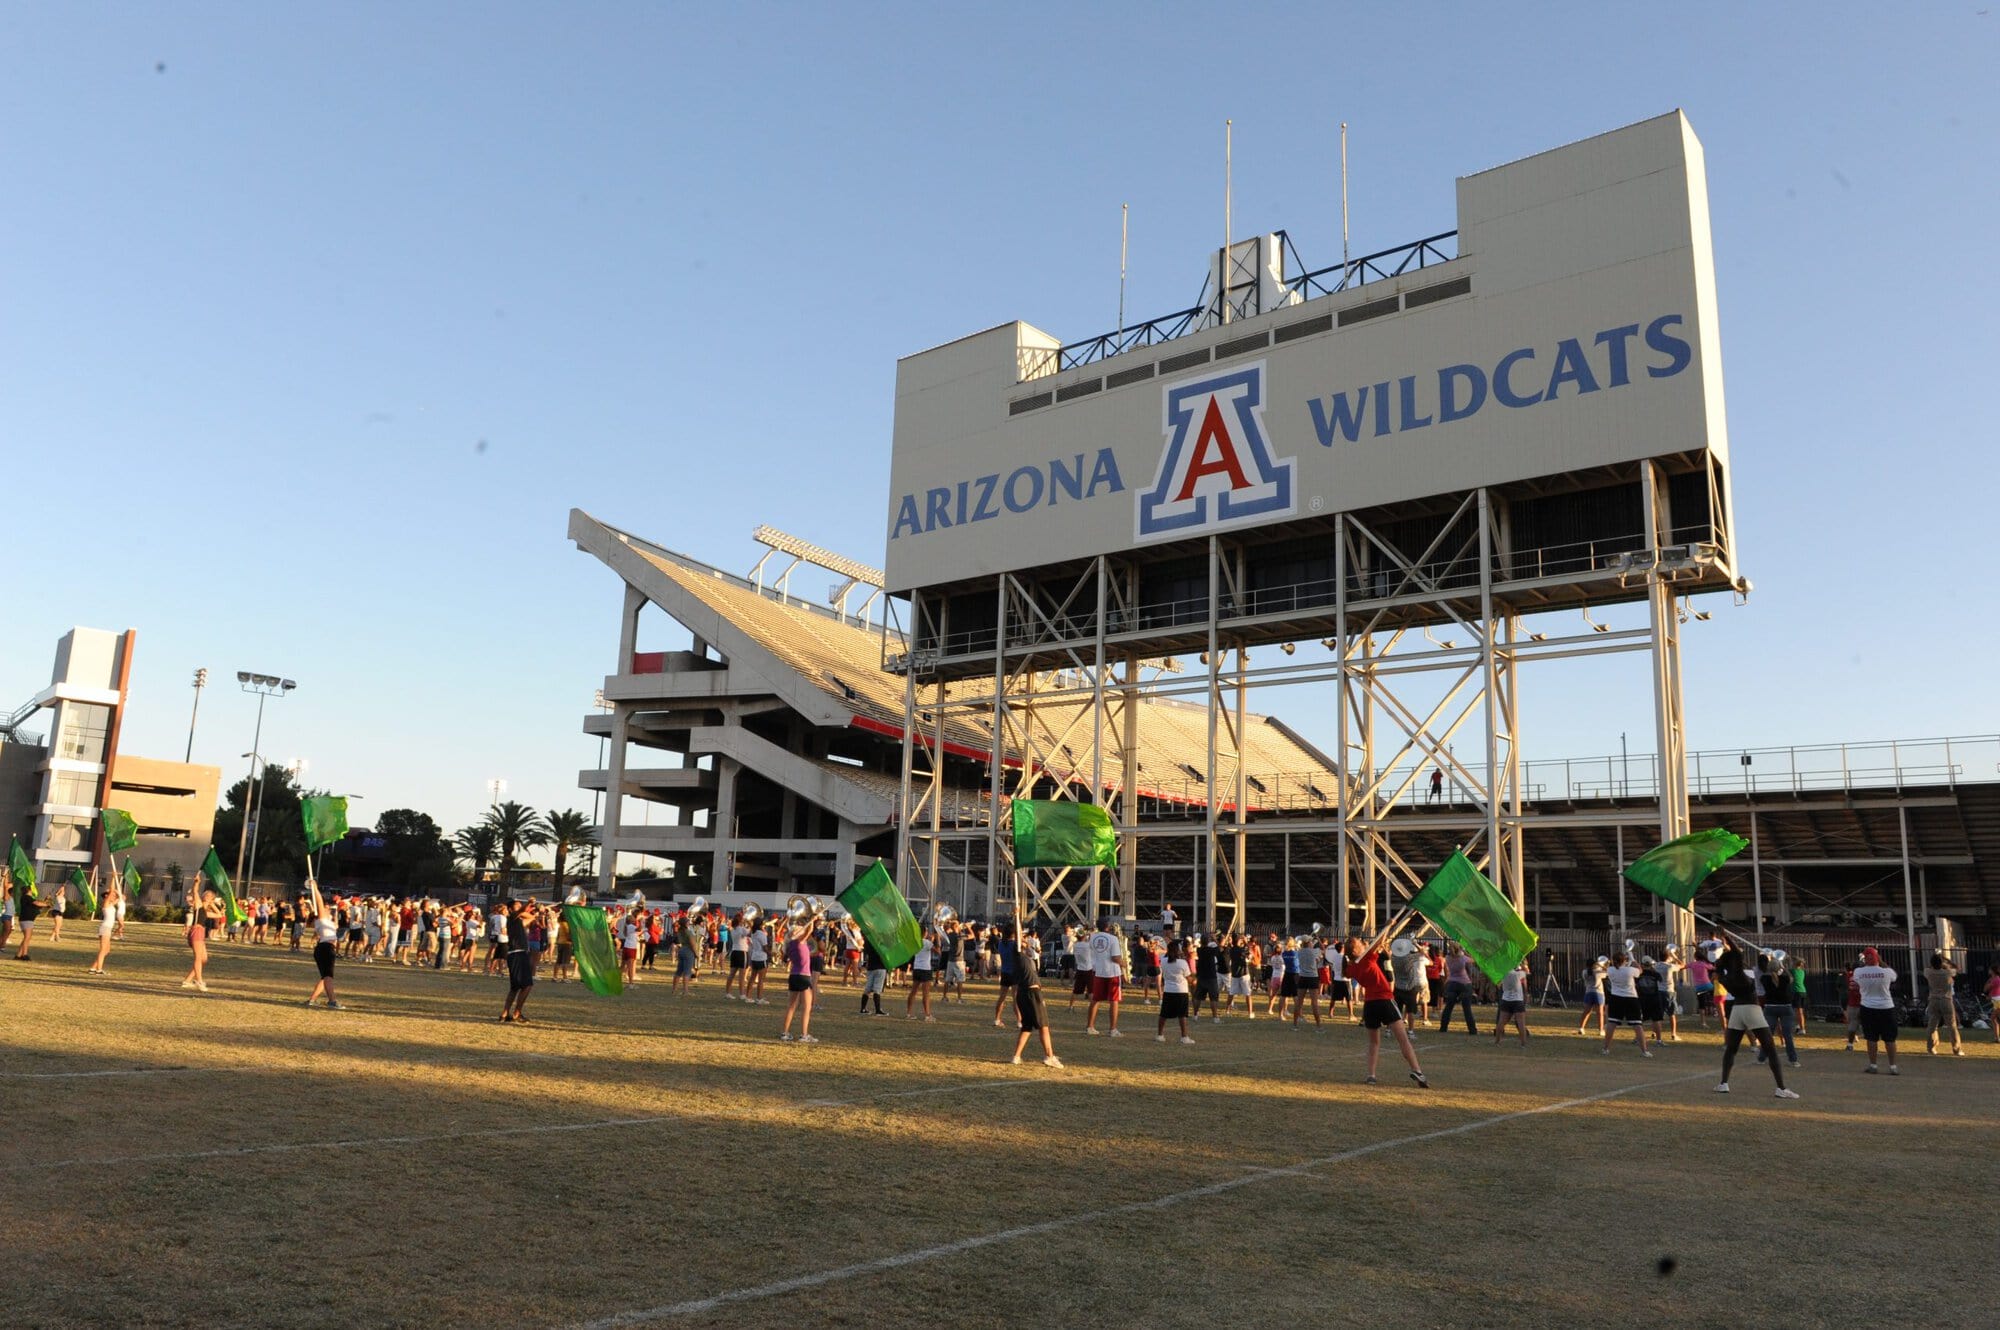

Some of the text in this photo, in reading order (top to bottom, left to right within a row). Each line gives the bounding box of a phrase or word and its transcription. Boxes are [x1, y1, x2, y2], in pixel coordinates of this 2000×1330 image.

[890, 314, 1692, 543] ARIZONA A WILDCATS
